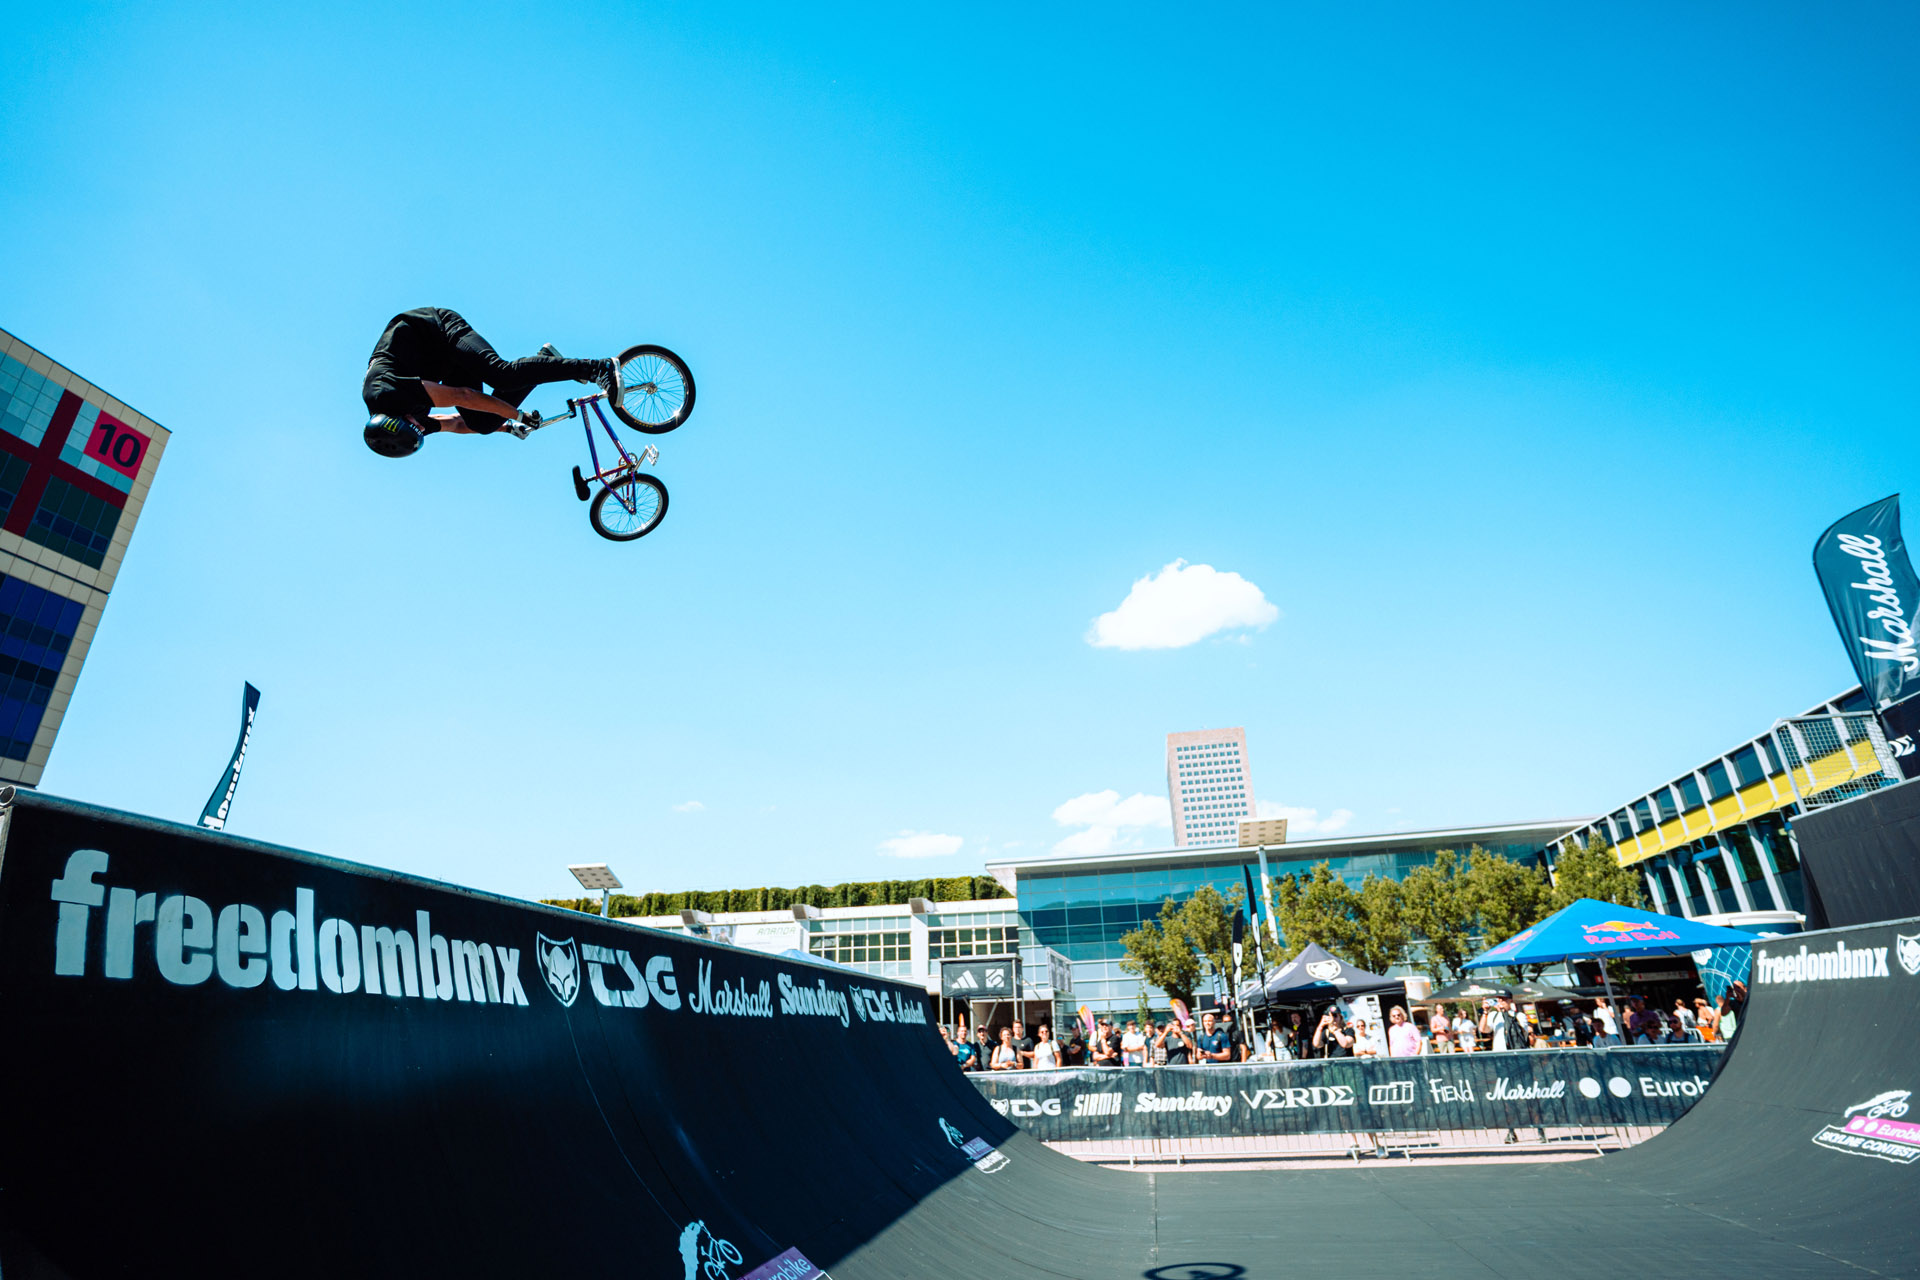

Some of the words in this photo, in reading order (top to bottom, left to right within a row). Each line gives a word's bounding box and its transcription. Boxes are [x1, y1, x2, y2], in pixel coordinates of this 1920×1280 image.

[99, 424, 141, 468] 10
[1837, 533, 1917, 672] Marshall
[51, 849, 529, 1006] freedombmx
[1583, 932, 1633, 945] Red
[1630, 930, 1680, 941] Bull
[581, 943, 682, 1011] TSG
[1757, 940, 1890, 984] freedombmx
[689, 958, 773, 1018] Marshall
[777, 972, 849, 1028] Sunday
[862, 988, 896, 1022] TSG
[1010, 1098, 1061, 1117] TSG
[1134, 1091, 1233, 1117] Sunday
[1239, 1085, 1355, 1109] VERDE
[1486, 1076, 1565, 1100] Marshall
[1818, 1131, 1865, 1148] SKYLINE
[1861, 1140, 1920, 1159] CONTEST
